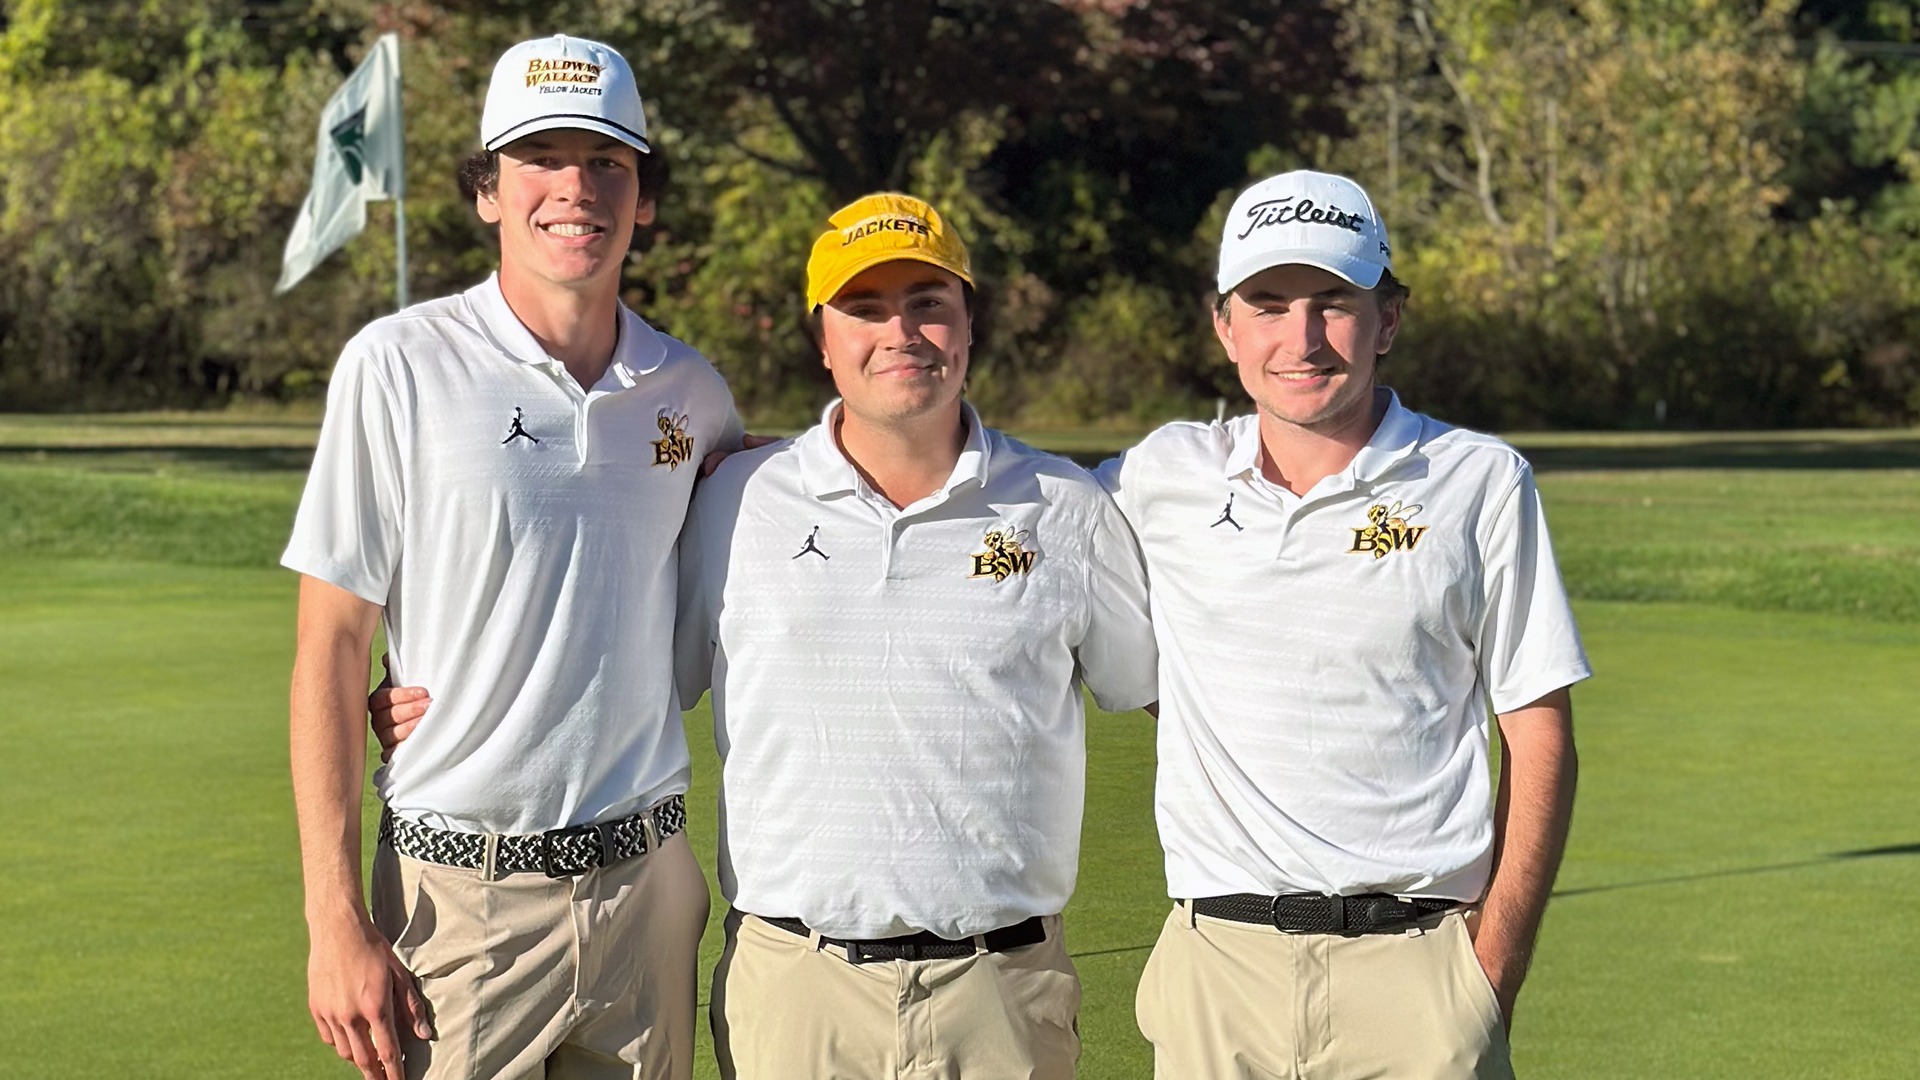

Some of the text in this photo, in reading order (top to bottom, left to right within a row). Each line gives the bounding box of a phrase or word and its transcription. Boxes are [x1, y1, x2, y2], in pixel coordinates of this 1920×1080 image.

[525, 73, 598, 87] WALLACE
[539, 85, 602, 96] YELLOW JACKETS
[1237, 195, 1365, 241] Titleist
[841, 218, 930, 247] JACKETS
